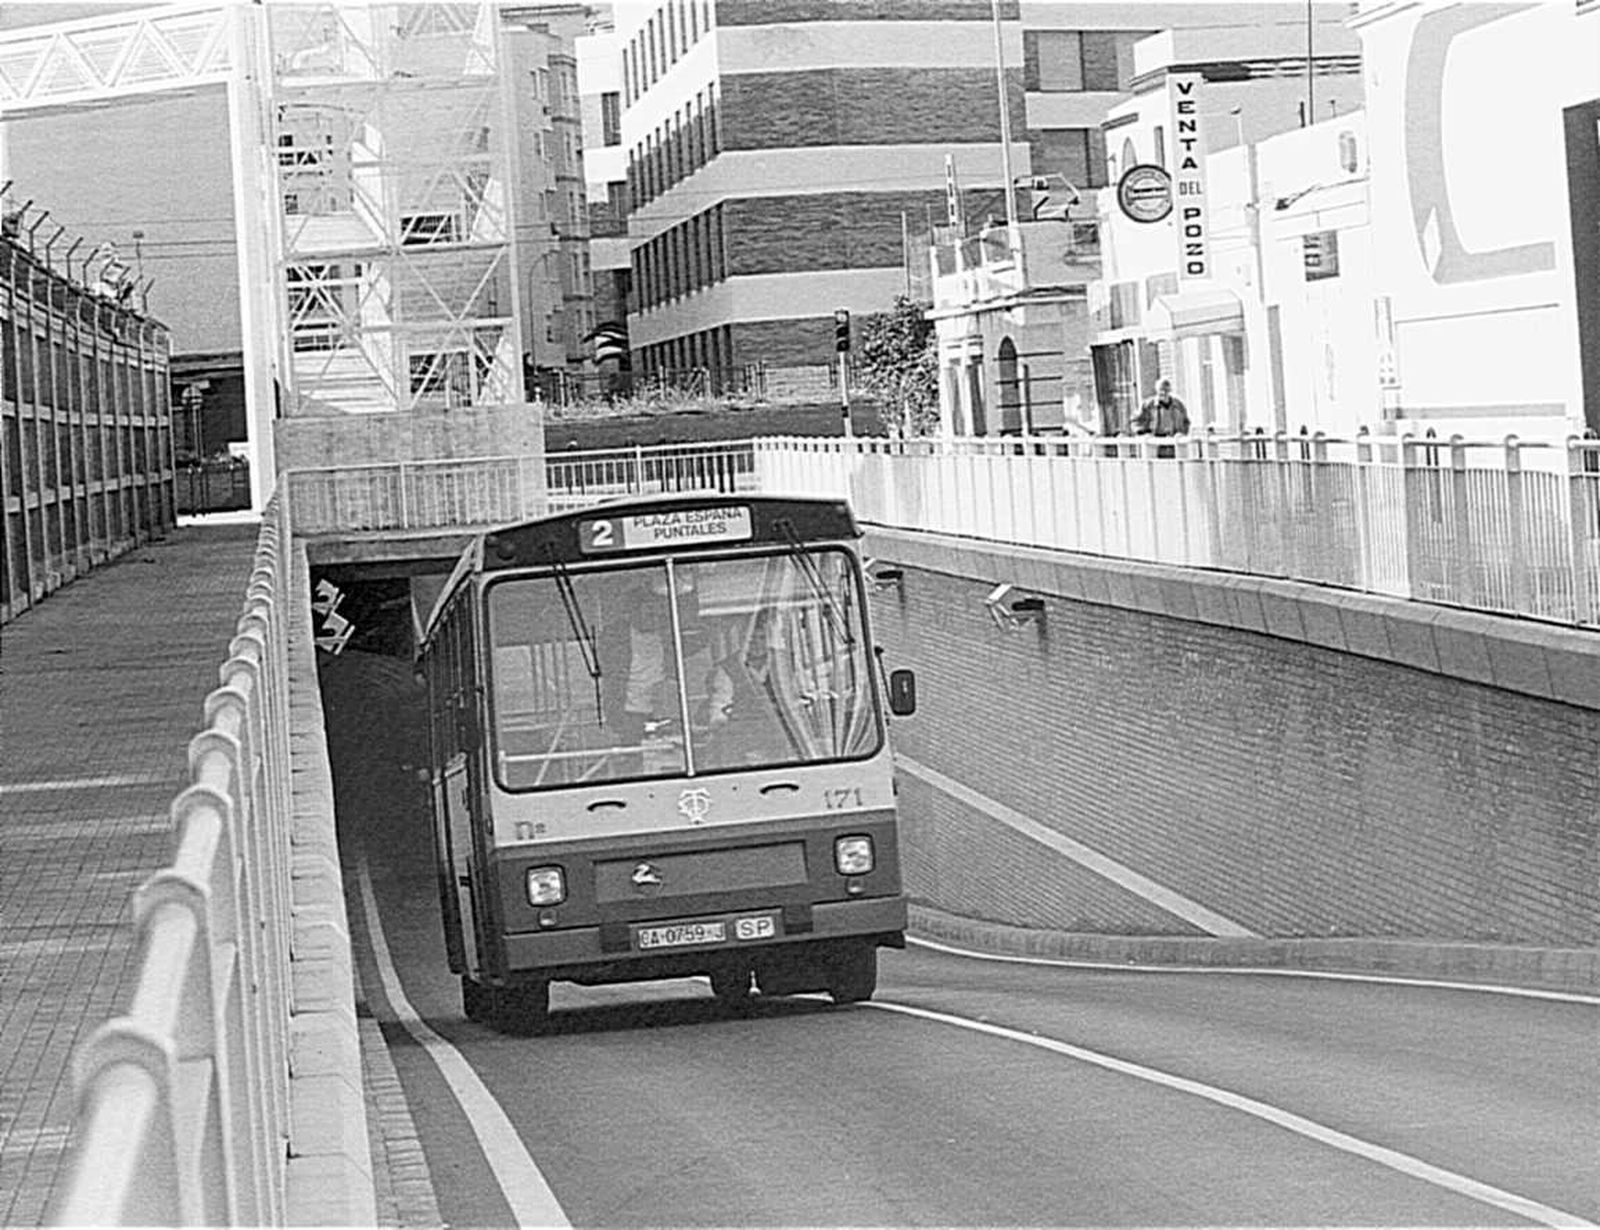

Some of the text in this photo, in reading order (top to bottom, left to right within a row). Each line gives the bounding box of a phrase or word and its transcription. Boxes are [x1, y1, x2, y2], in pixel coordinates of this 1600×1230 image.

[1177, 82, 1204, 275] VENTA DEL POZO
[634, 513, 681, 527] PLAZA
[592, 520, 613, 546] 2
[654, 522, 727, 539] PUNTALES
[824, 787, 863, 809] 171
[741, 919, 770, 936] SP
